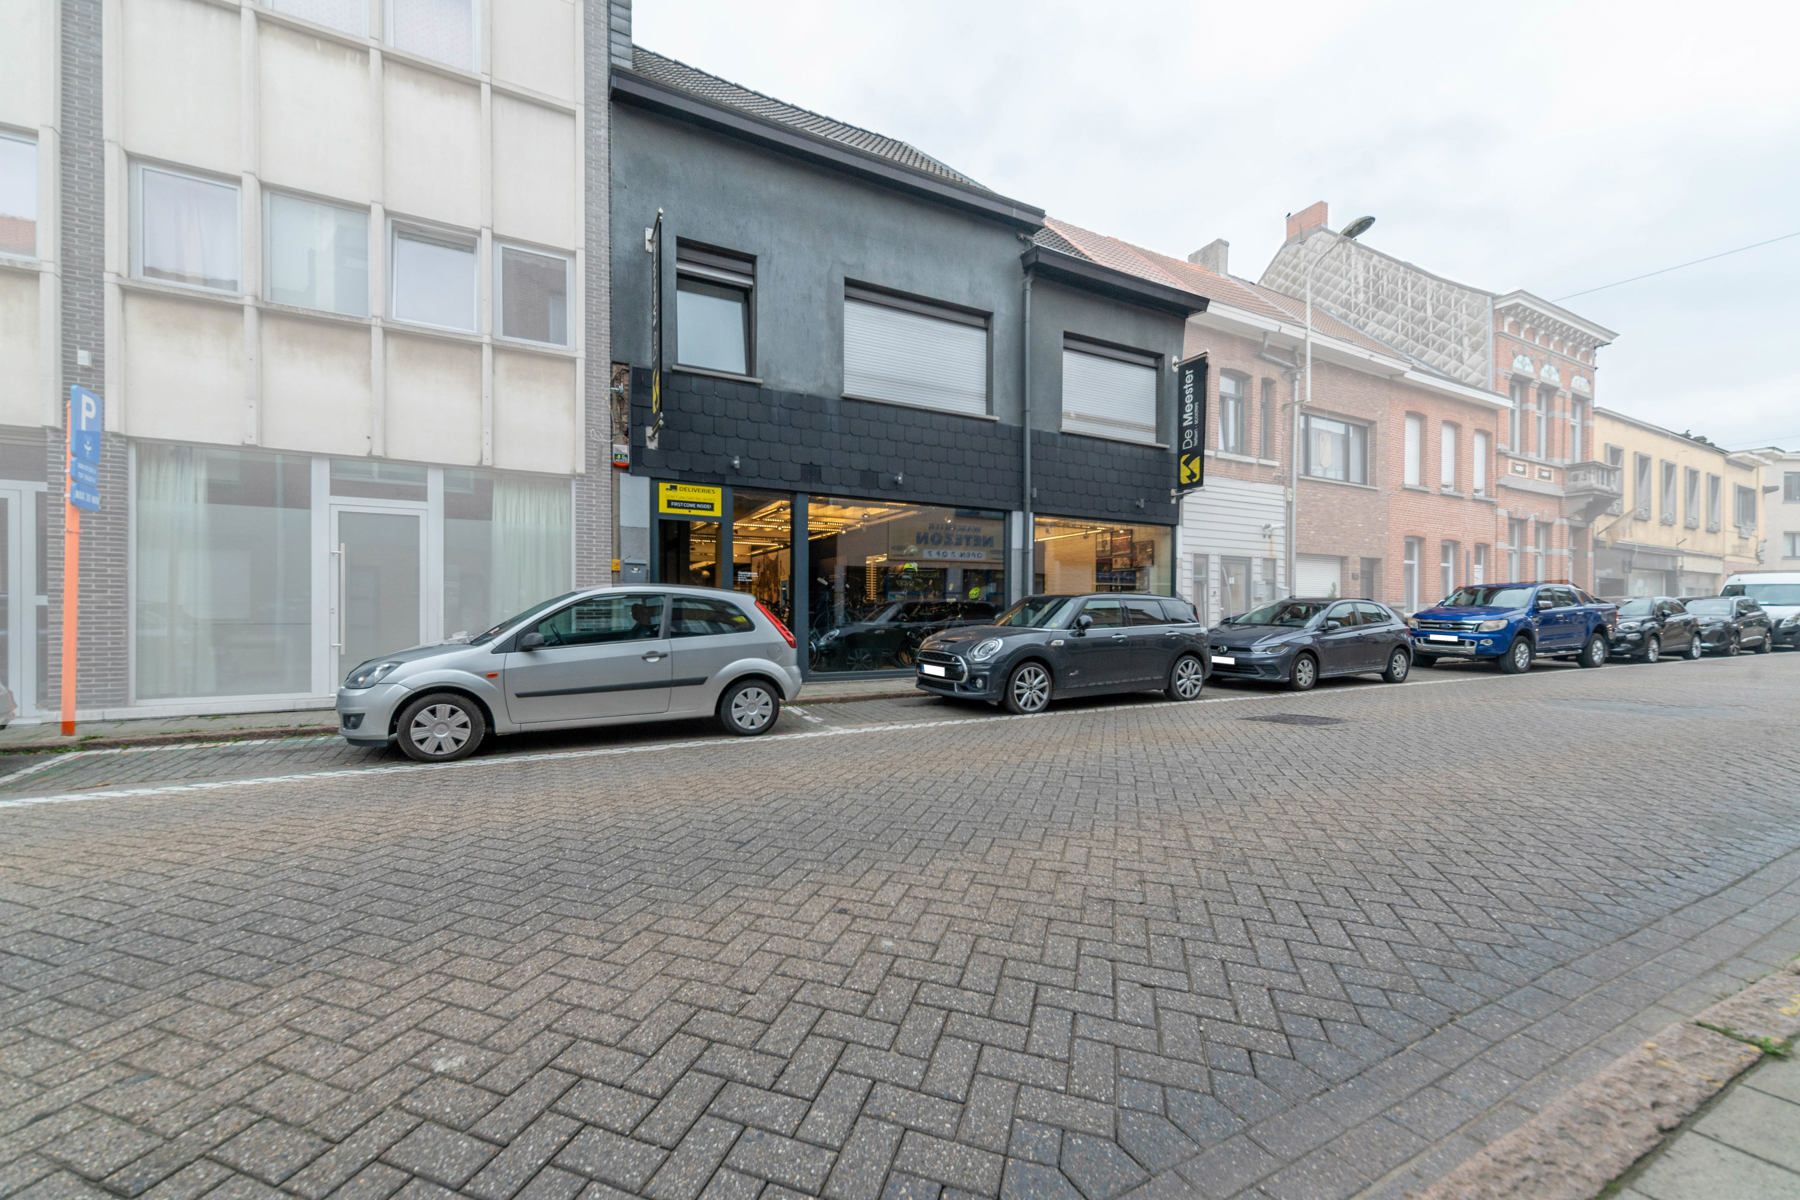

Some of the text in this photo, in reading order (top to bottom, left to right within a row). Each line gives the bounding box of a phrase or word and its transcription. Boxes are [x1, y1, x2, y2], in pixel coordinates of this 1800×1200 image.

[81, 394, 96, 432] P
[1182, 369, 1194, 450] De Meester
[678, 486, 716, 495] DELIVERIES
